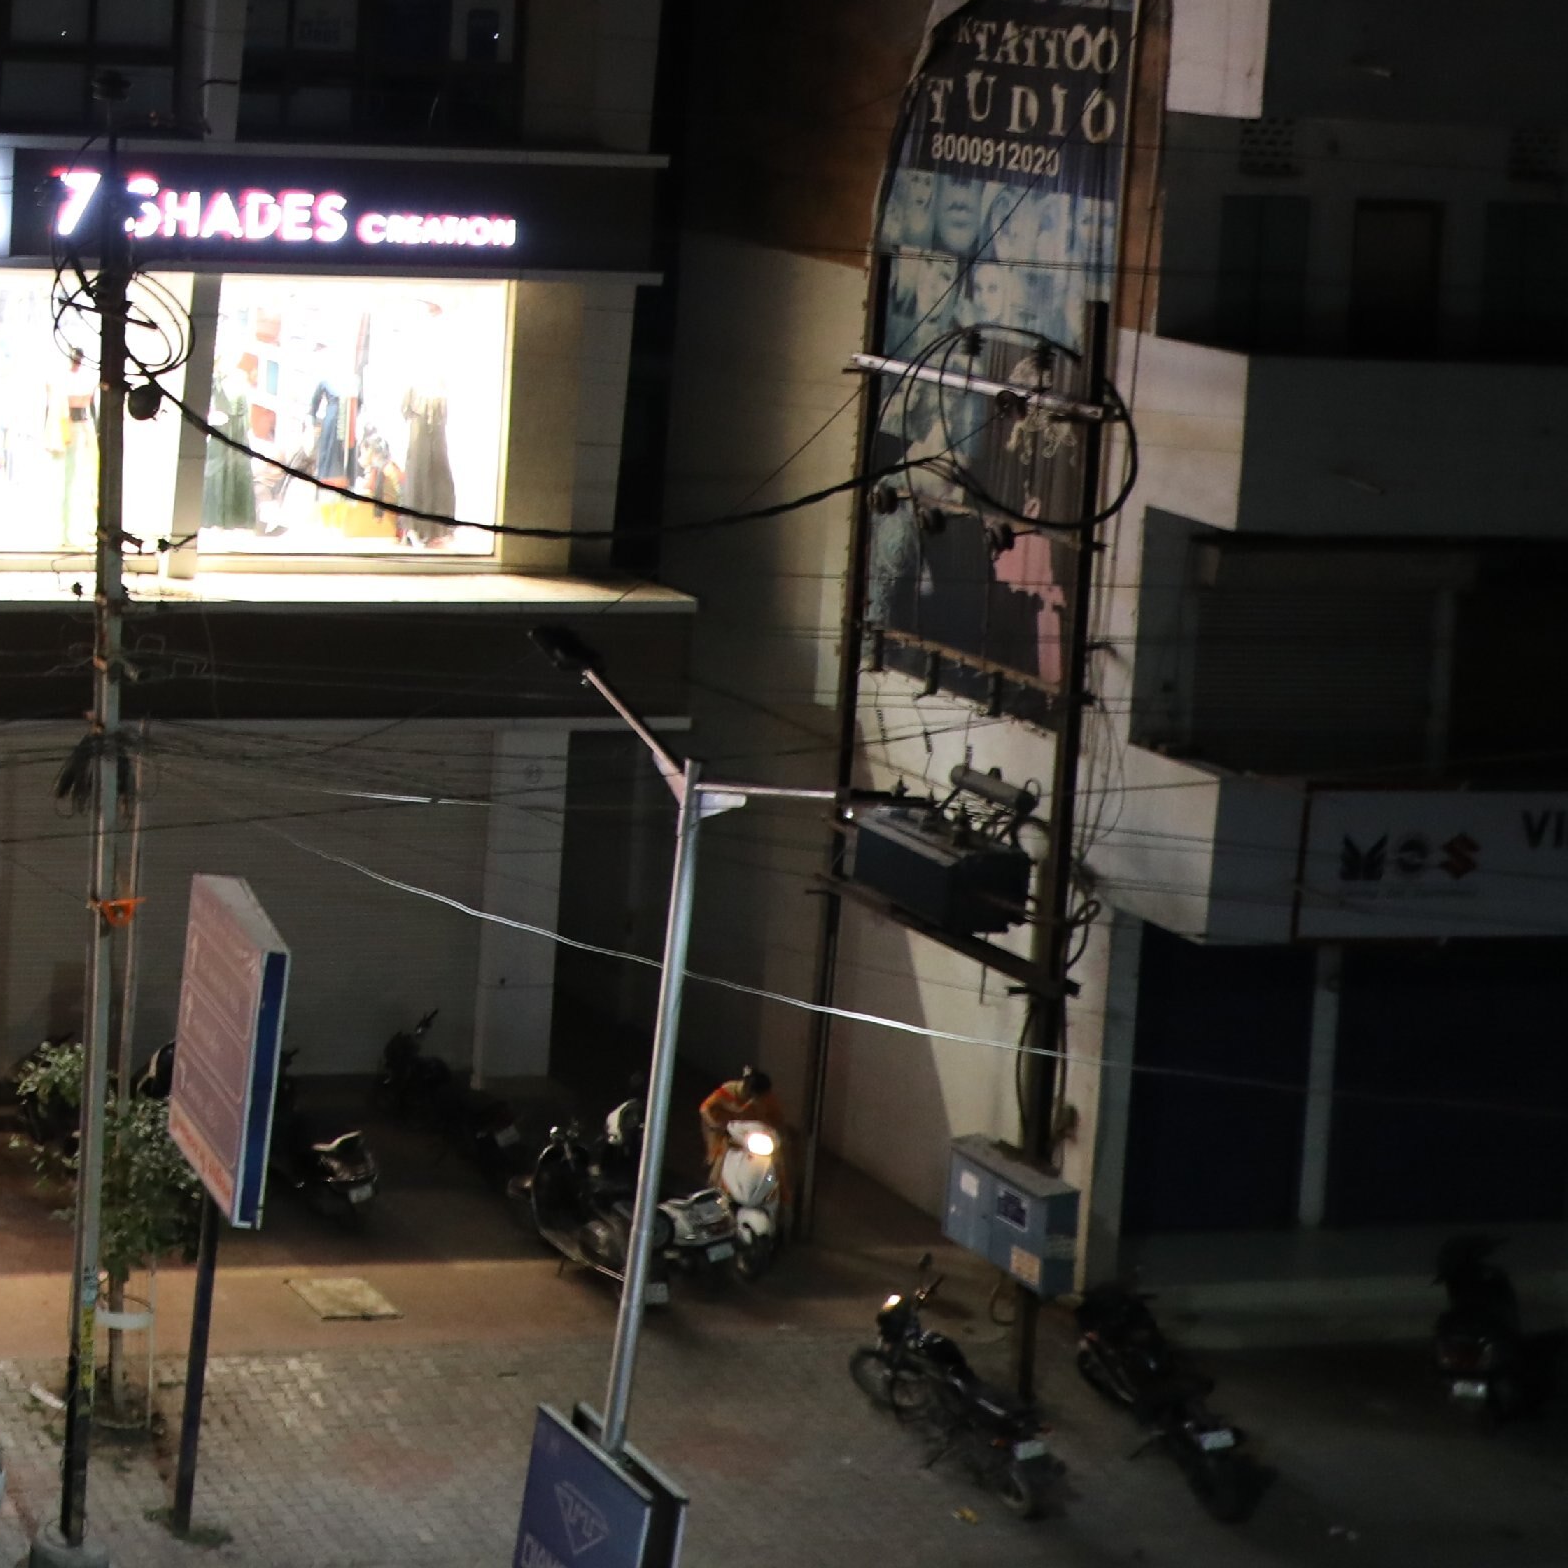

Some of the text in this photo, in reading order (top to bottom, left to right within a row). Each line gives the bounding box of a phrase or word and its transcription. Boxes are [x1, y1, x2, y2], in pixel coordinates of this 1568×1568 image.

[973, 19, 1119, 75] TATTOO
[931, 132, 1060, 178] 8000912020
[124, 177, 349, 243] SHADES
[360, 215, 517, 247] CREATION
